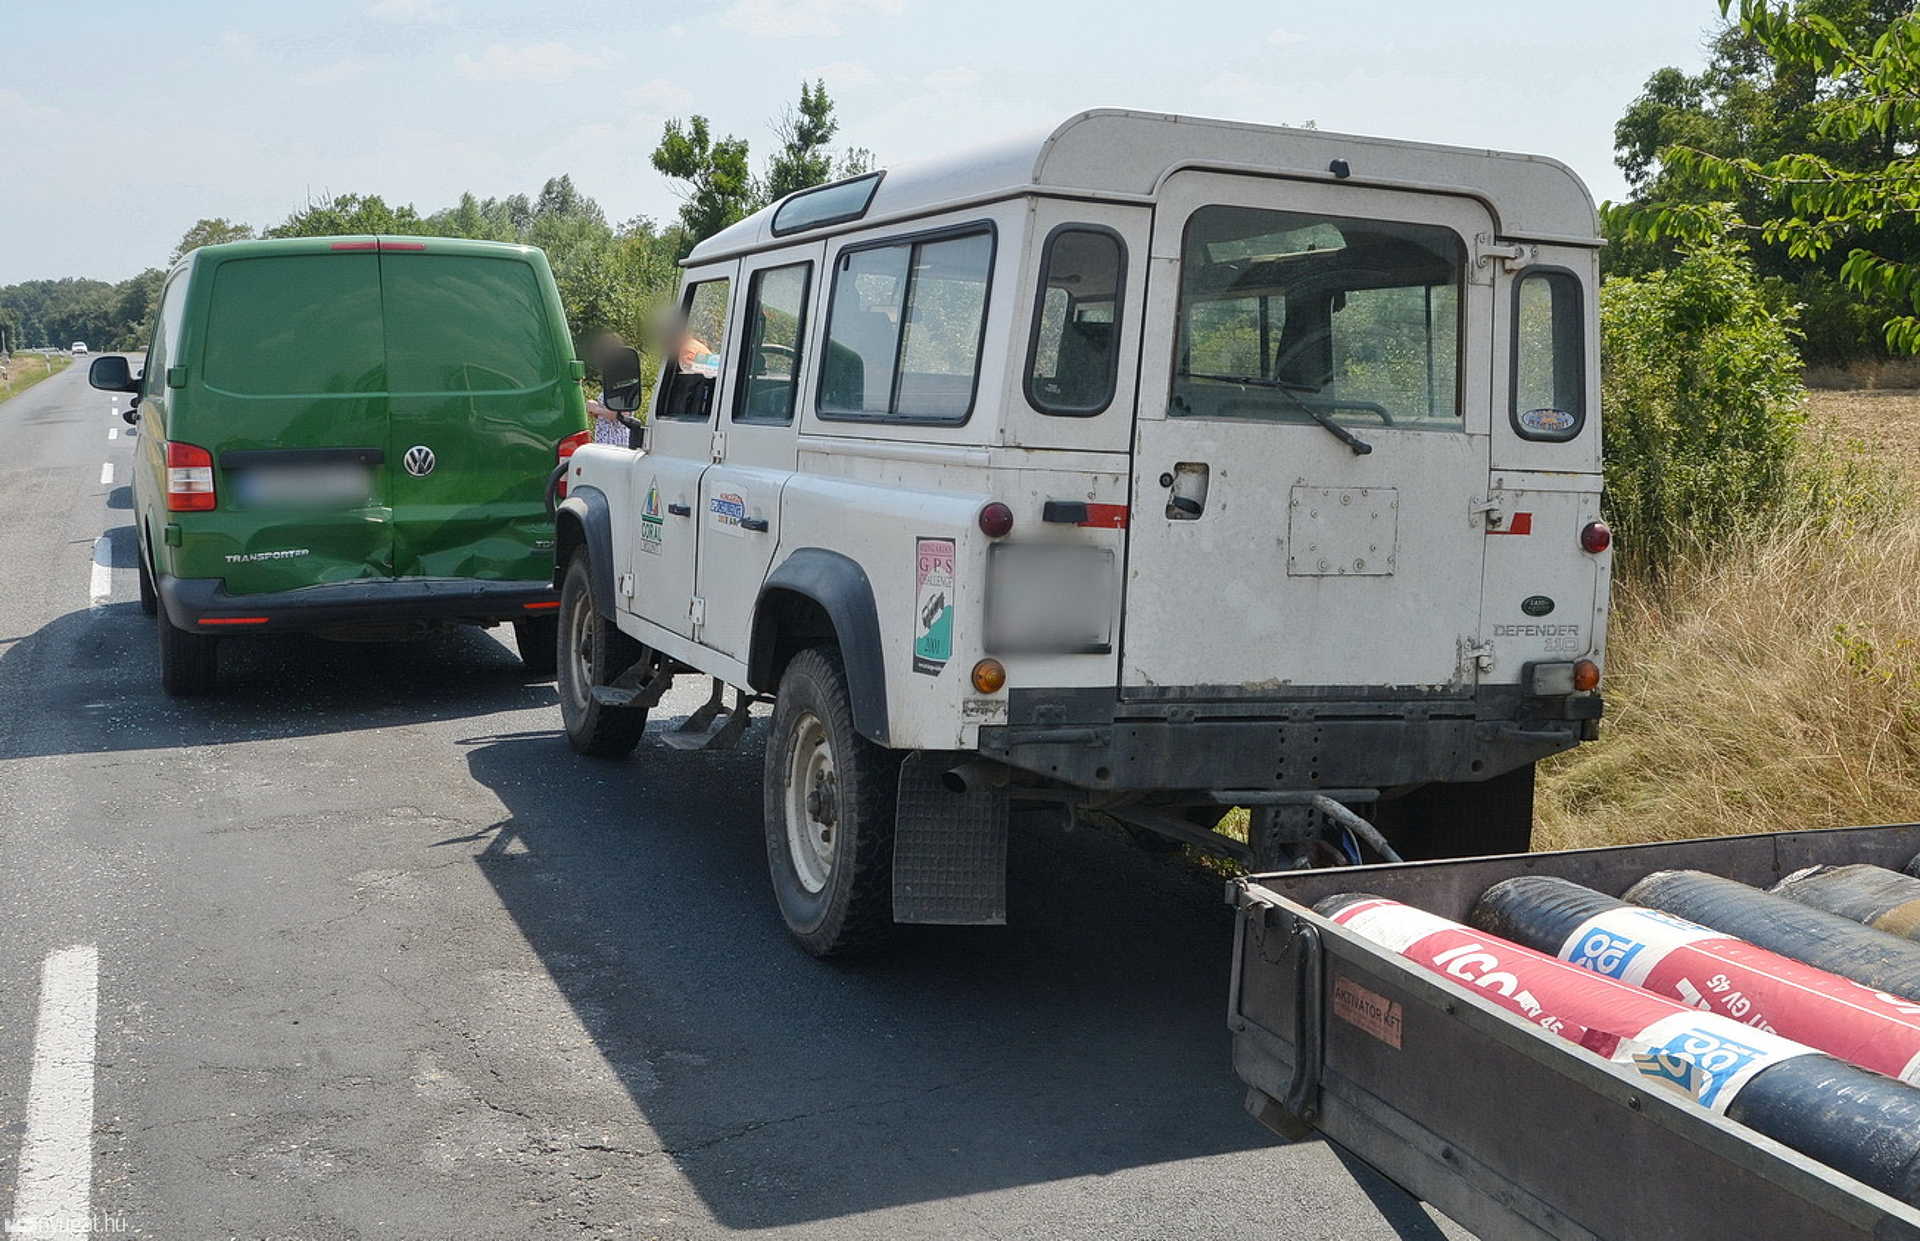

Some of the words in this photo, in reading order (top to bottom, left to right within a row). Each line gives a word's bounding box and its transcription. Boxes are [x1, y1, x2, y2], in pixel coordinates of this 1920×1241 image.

[224, 548, 310, 563] TRANSPORTER
[1493, 624, 1579, 637] DEFENDER
[1706, 974, 1731, 993] 45
[1336, 987, 1382, 1019] AKTIVATOR
[1720, 991, 1751, 1018] GV
